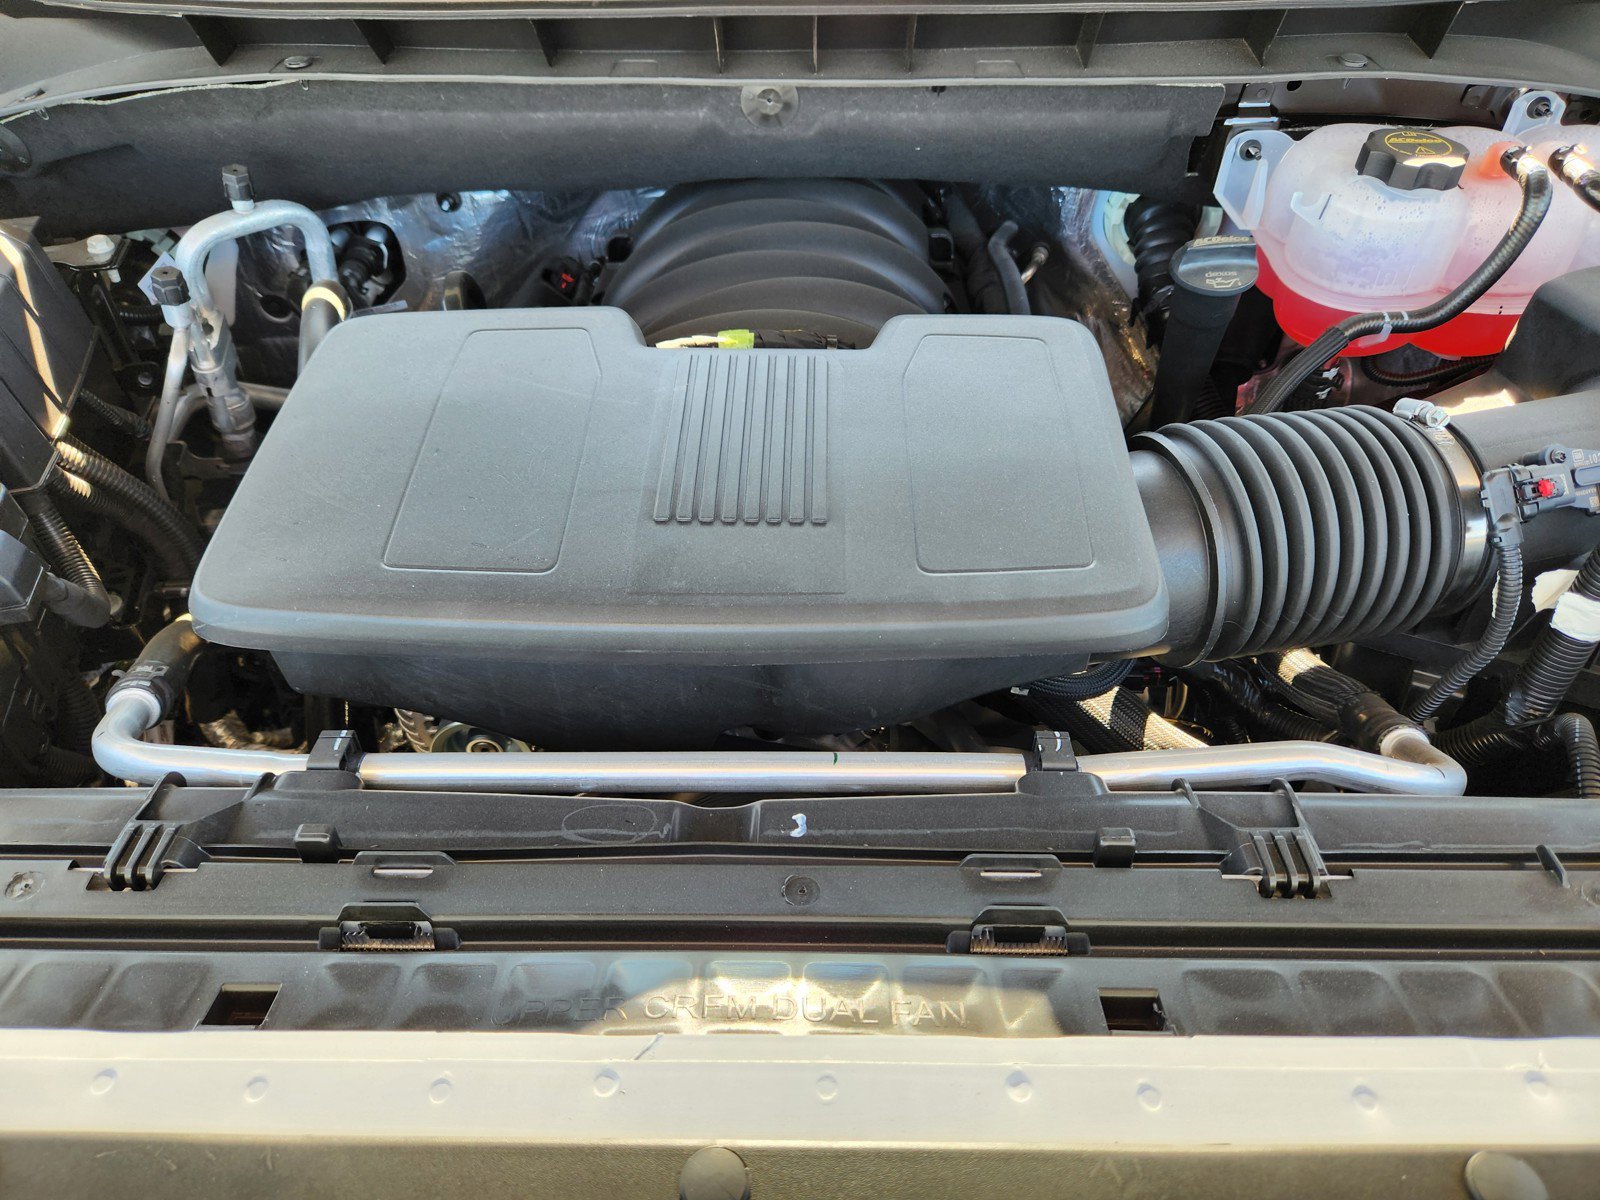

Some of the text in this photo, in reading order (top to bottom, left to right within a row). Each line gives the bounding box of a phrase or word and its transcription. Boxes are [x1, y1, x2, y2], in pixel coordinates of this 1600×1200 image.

[1193, 235, 1250, 248] ACDelco
[490, 993, 967, 1027] UPPER CRFM DUAL FAN
